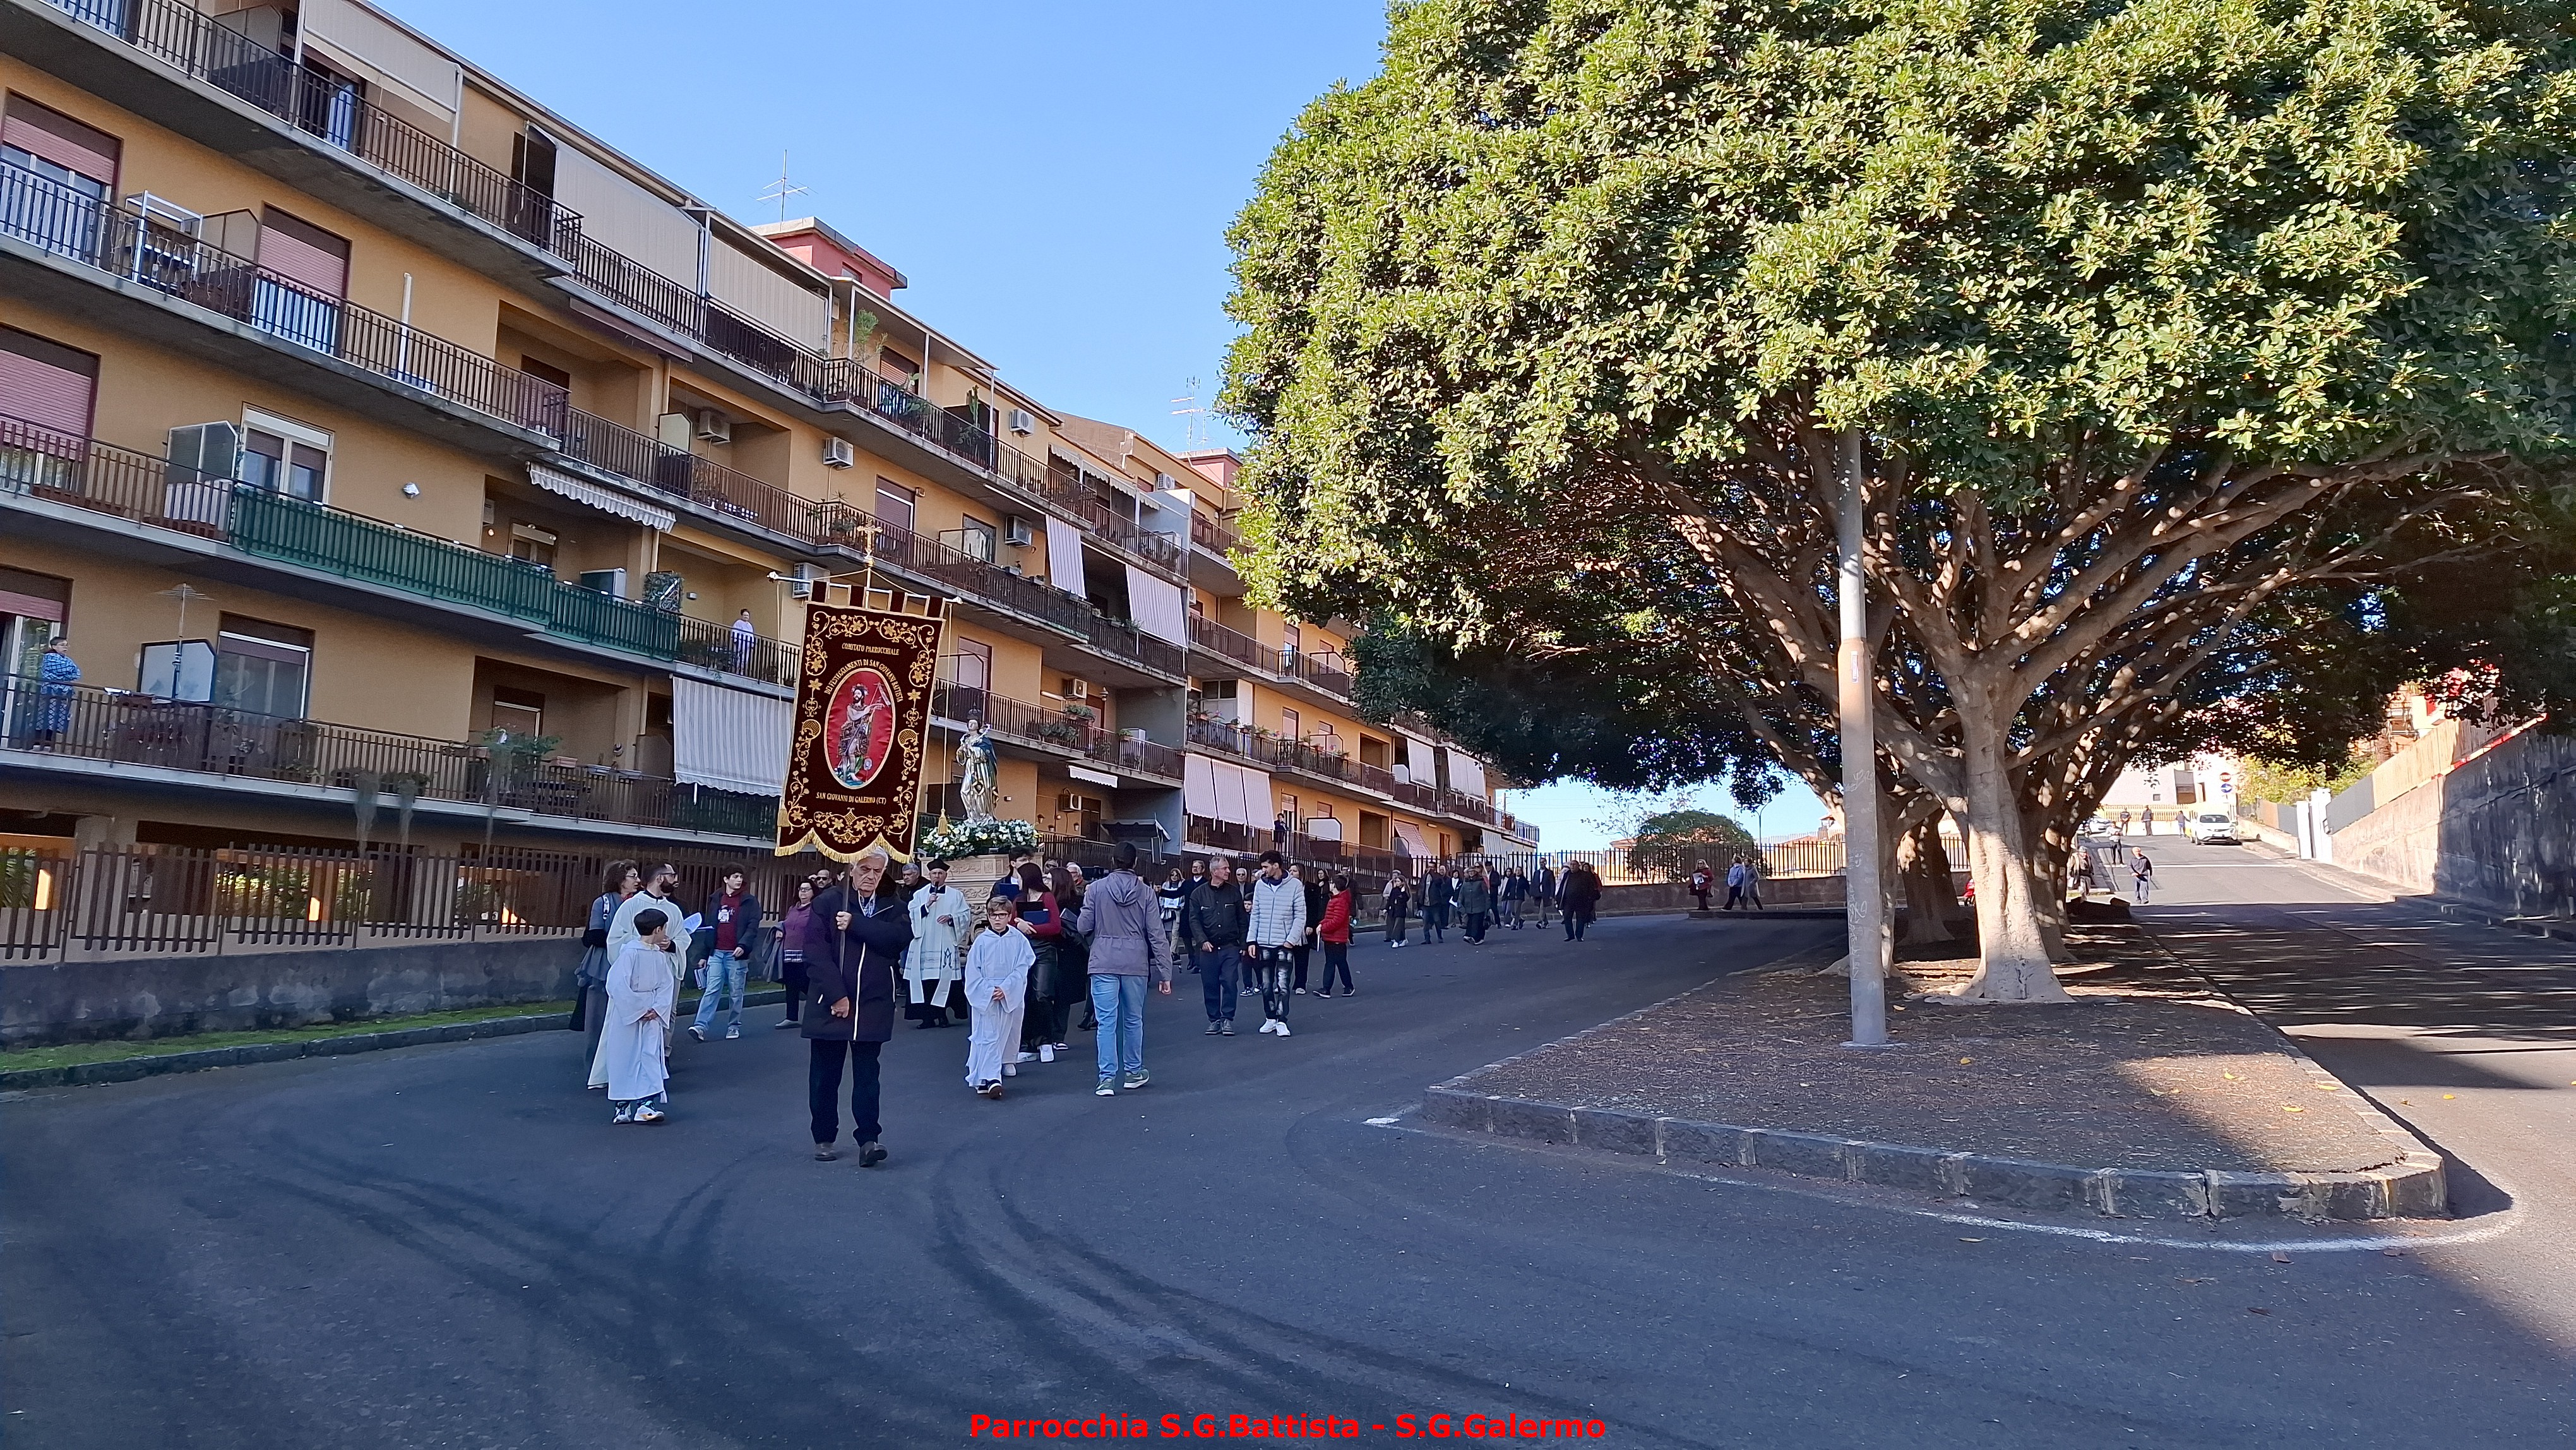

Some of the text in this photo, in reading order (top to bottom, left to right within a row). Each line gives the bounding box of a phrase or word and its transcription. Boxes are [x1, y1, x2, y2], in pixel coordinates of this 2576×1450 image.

[842, 643, 899, 655] COMITATO PARROCCHIALE
[824, 686, 833, 695] DEI
[869, 659, 880, 668] SAN
[879, 664, 896, 682] GIOVANNI
[891, 681, 903, 702] BATTISTA
[826, 793, 848, 802] GIOVANNI
